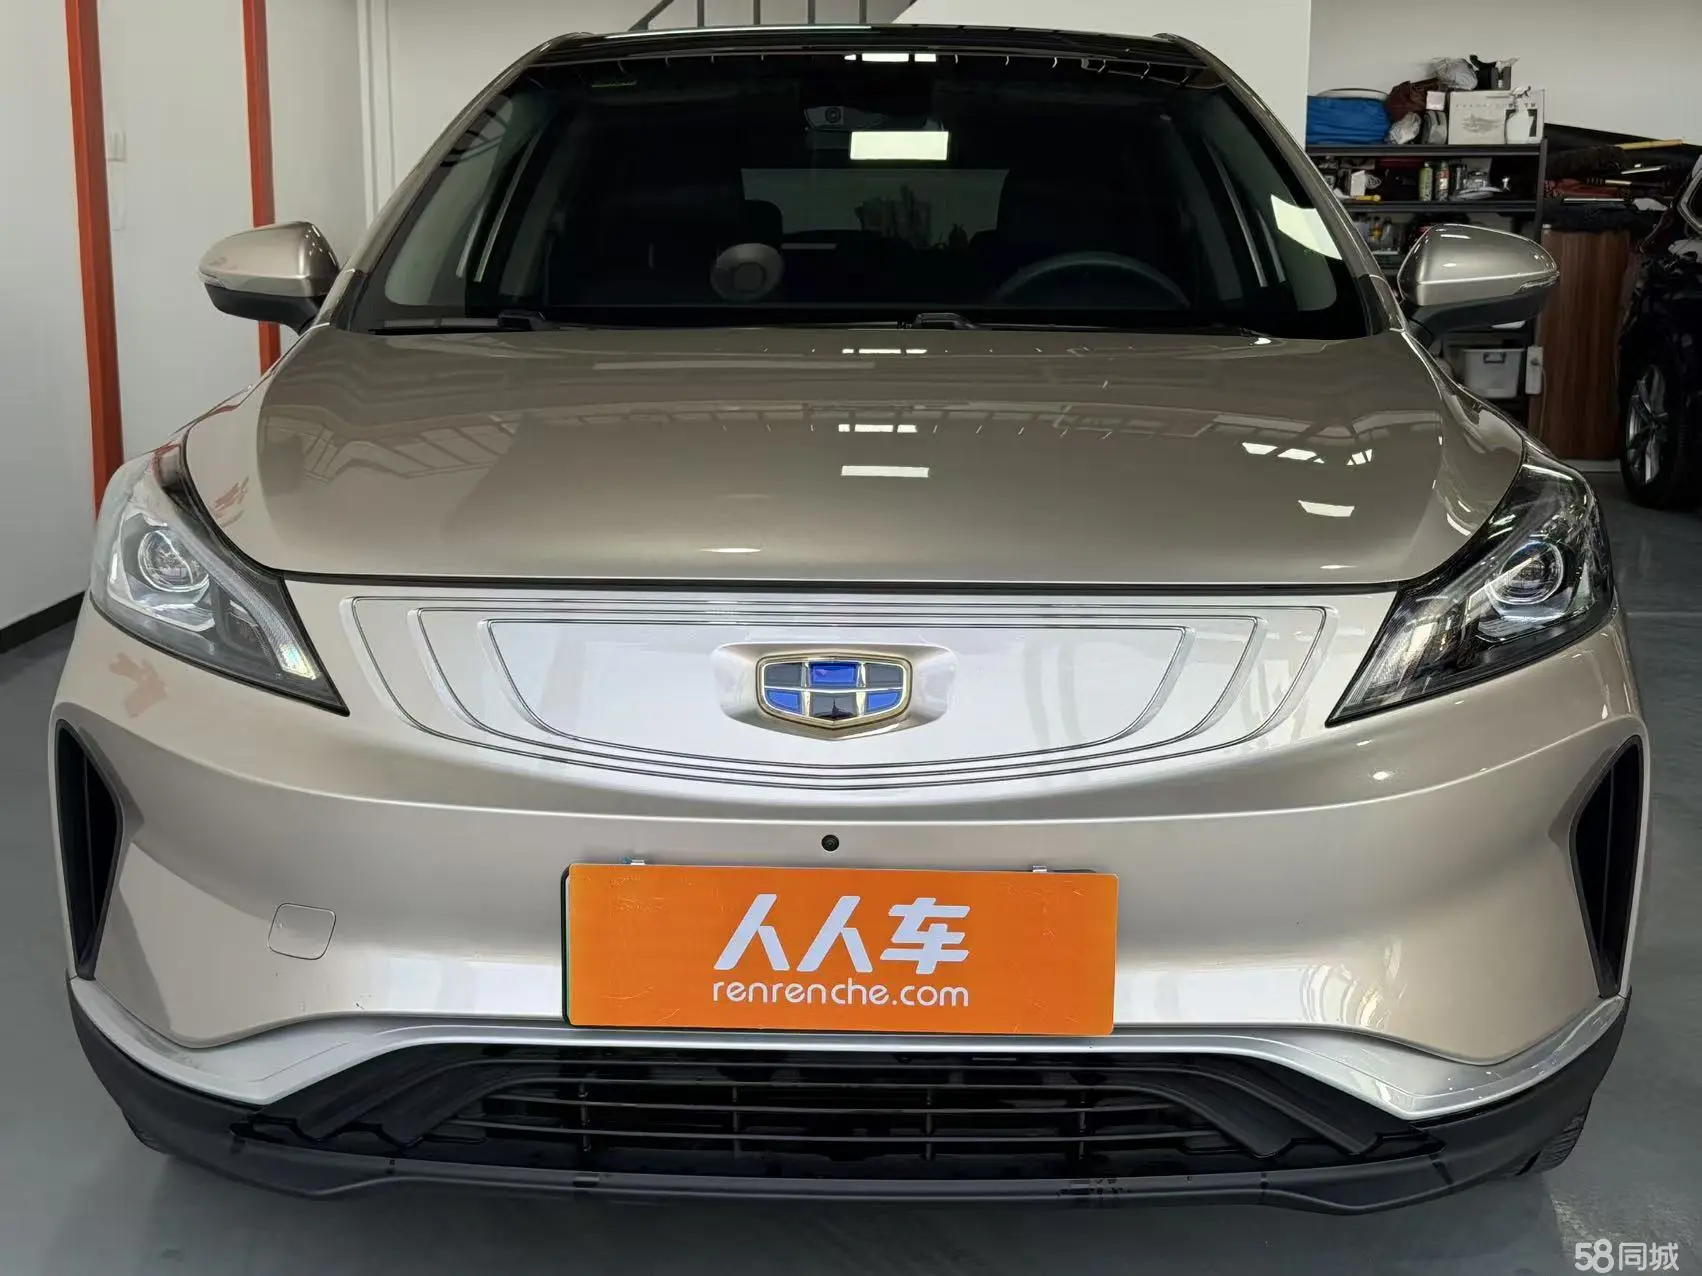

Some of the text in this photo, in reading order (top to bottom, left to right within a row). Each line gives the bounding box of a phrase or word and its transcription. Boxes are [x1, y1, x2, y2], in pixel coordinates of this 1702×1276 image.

[713, 893, 971, 975] 人人车
[712, 977, 969, 1007] renrenche.com
